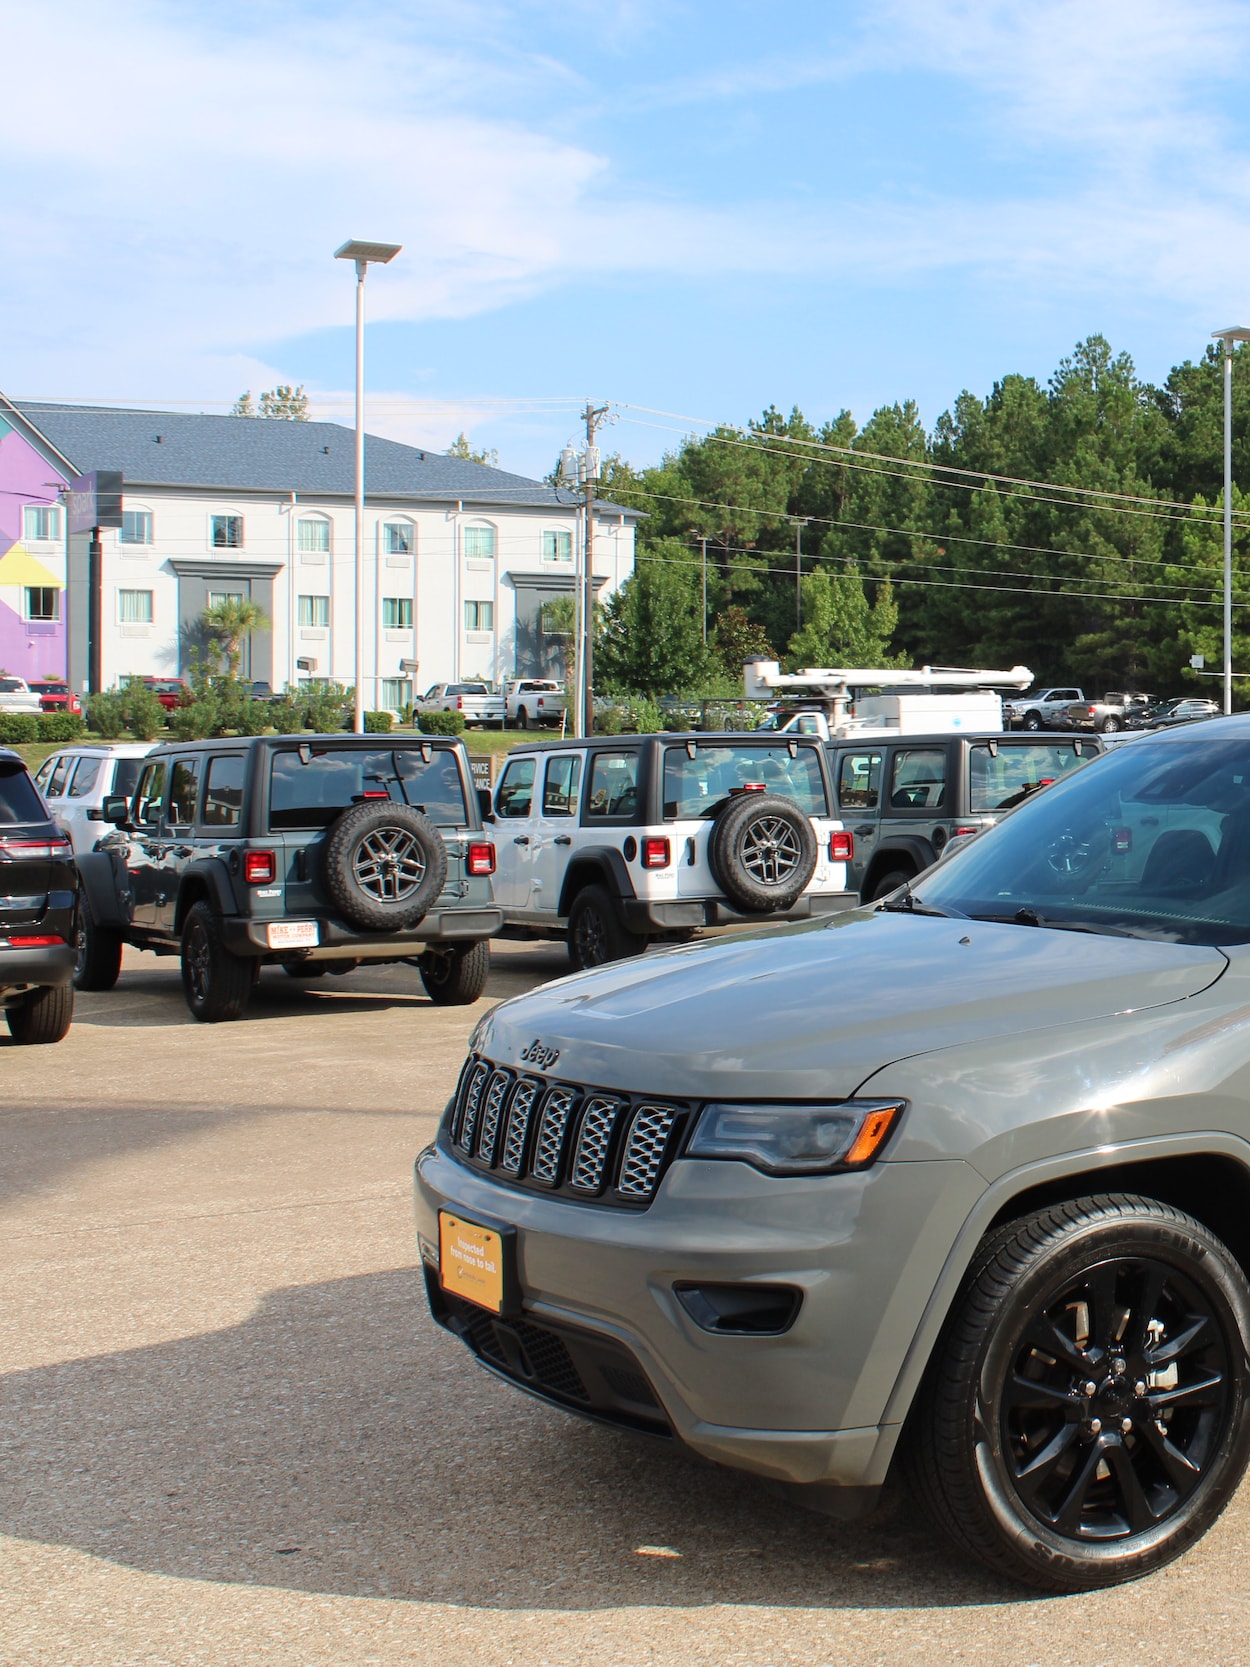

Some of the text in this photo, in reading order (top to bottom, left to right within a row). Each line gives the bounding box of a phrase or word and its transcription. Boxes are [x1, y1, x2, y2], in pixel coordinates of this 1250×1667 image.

[271, 924, 316, 934] MIKE PERRY
[520, 1039, 560, 1071] Jeep
[450, 1245, 463, 1260] from
[477, 1258, 485, 1269] to
[457, 1236, 485, 1257] Inspected
